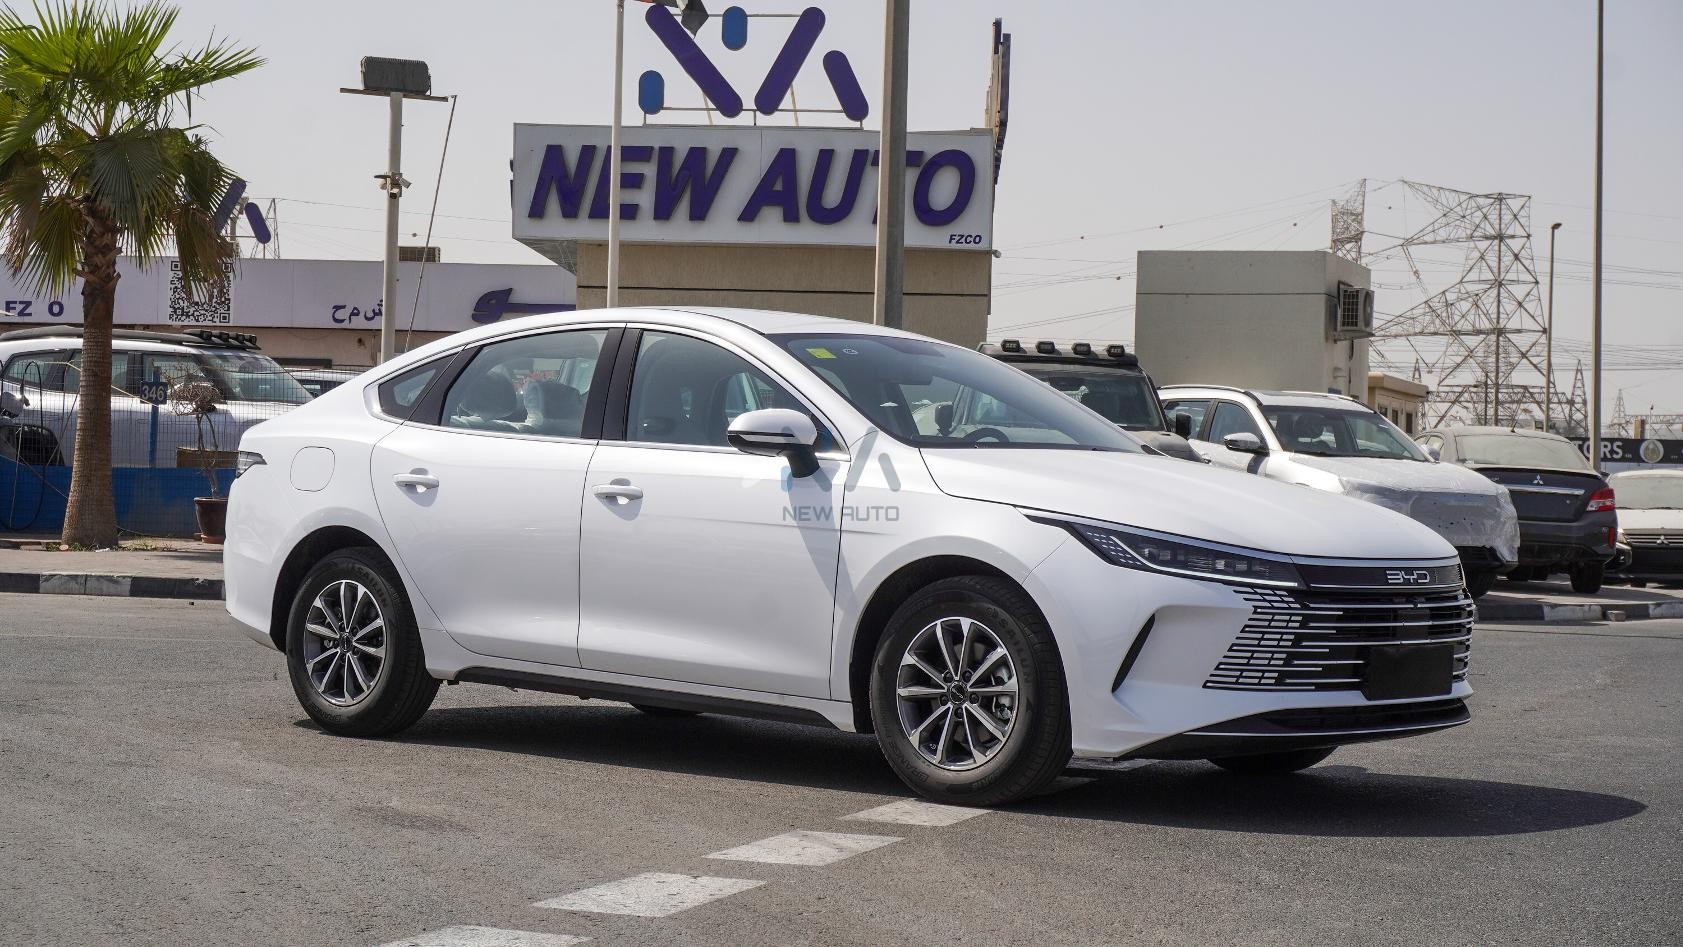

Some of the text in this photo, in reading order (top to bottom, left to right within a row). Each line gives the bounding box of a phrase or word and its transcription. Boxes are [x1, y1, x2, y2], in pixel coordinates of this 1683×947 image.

[527, 144, 739, 221] NEW
[949, 234, 983, 245] FZCO
[142, 384, 166, 401] 346
[1386, 570, 1430, 583] BYD
